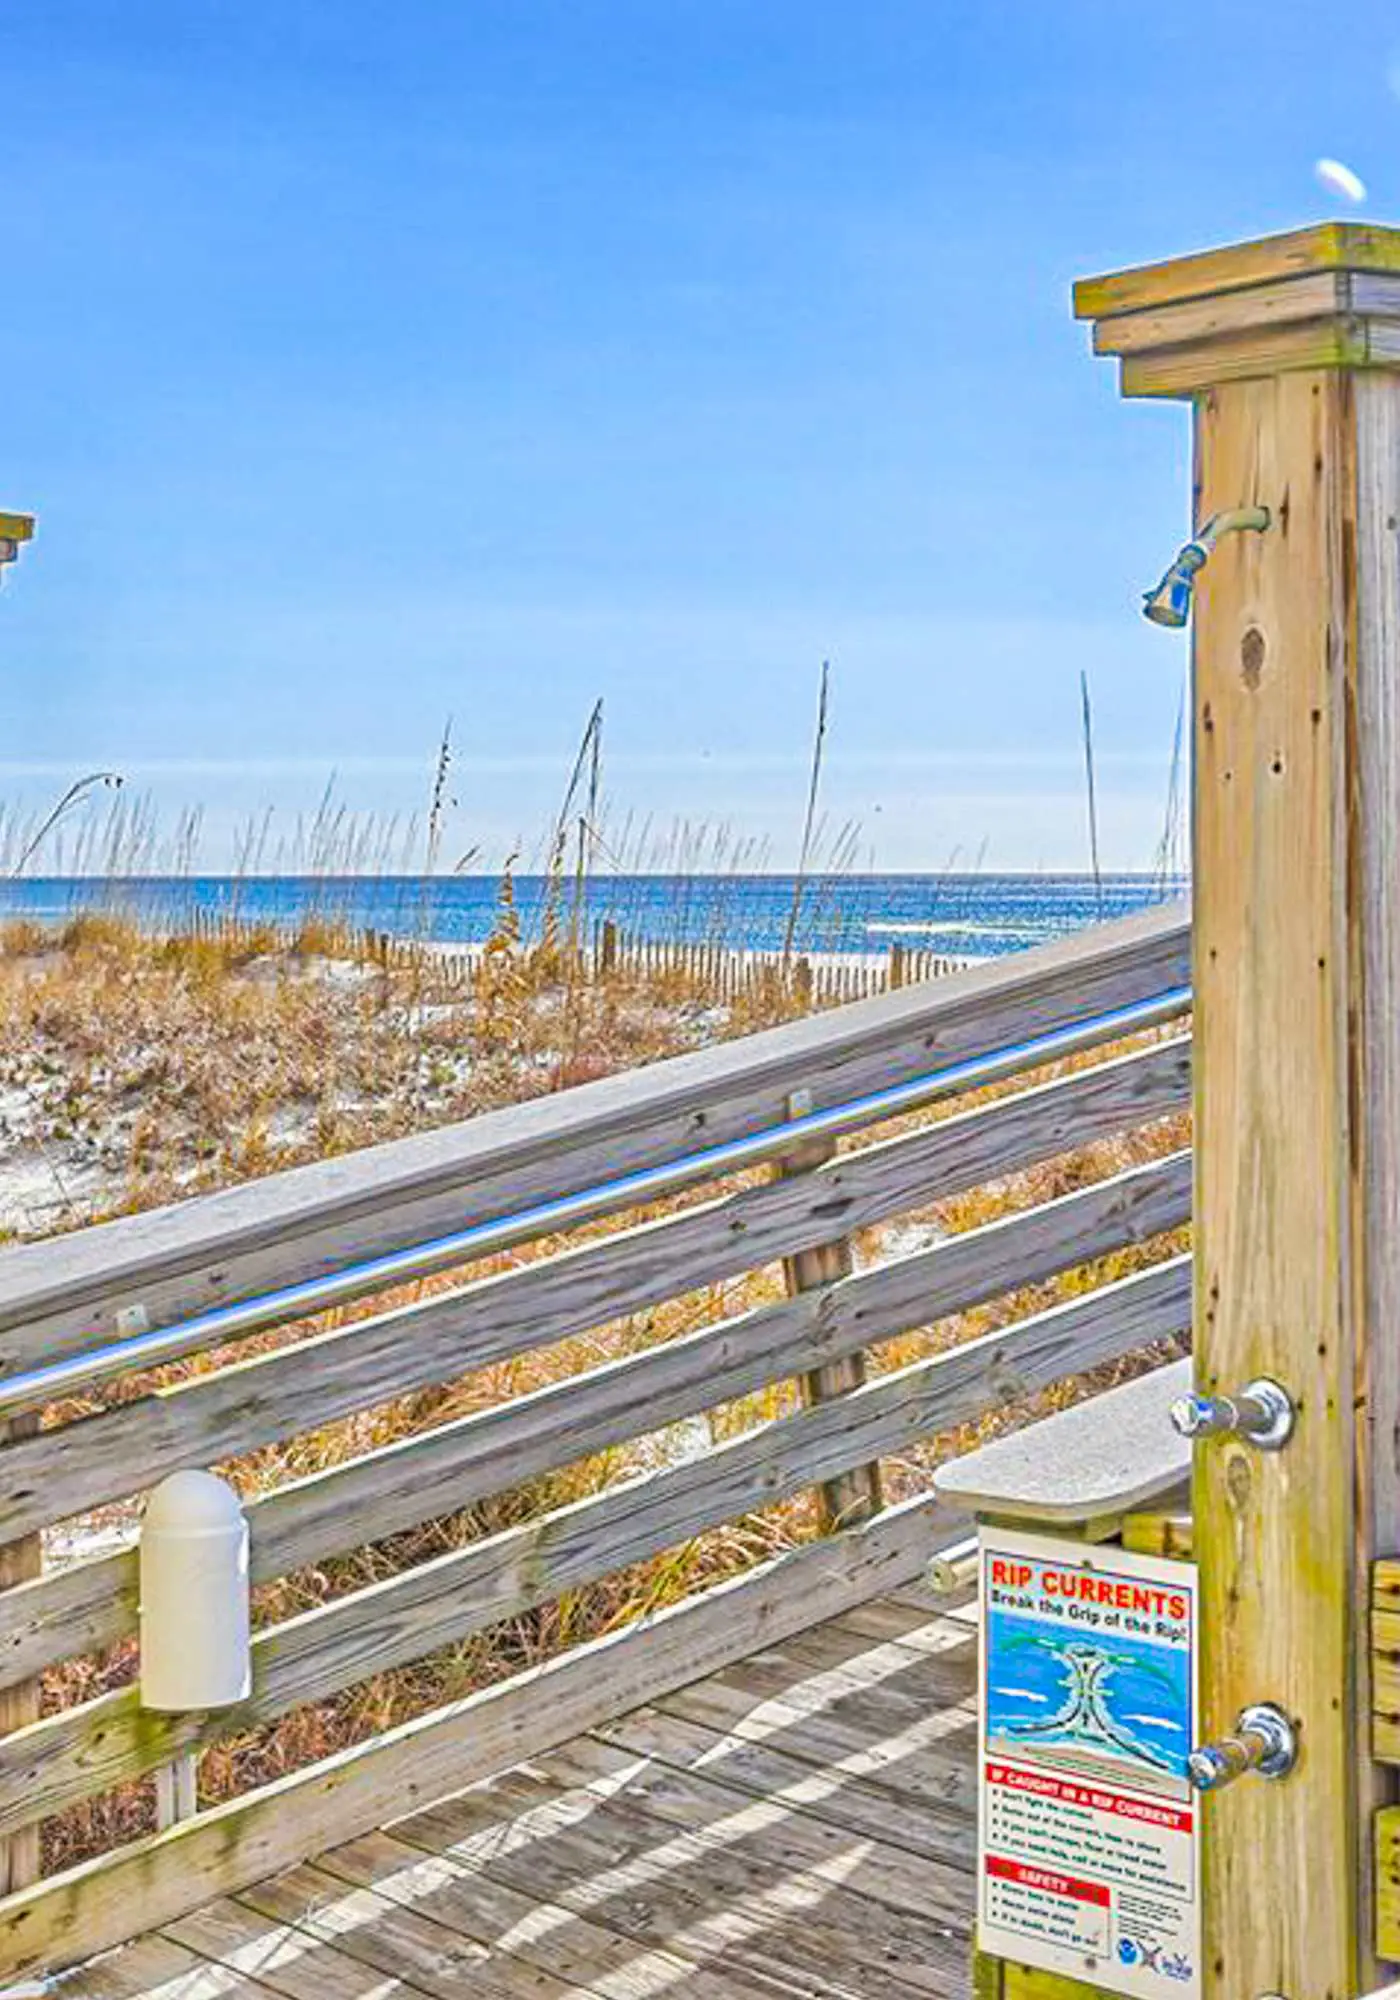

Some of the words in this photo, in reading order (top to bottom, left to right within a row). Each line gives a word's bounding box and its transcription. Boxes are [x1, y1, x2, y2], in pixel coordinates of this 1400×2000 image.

[991, 1589, 1033, 1612] Break
[1040, 1598, 1063, 1616] the
[1068, 1604, 1101, 1626] Grip
[1105, 1613, 1119, 1627] of
[1124, 1617, 1149, 1634] the
[1154, 1621, 1186, 1643] Rip!
[992, 1560, 1032, 1588] RIP
[1042, 1571, 1185, 1620] CURRENTS
[1018, 1868, 1068, 1892] SAFETY
